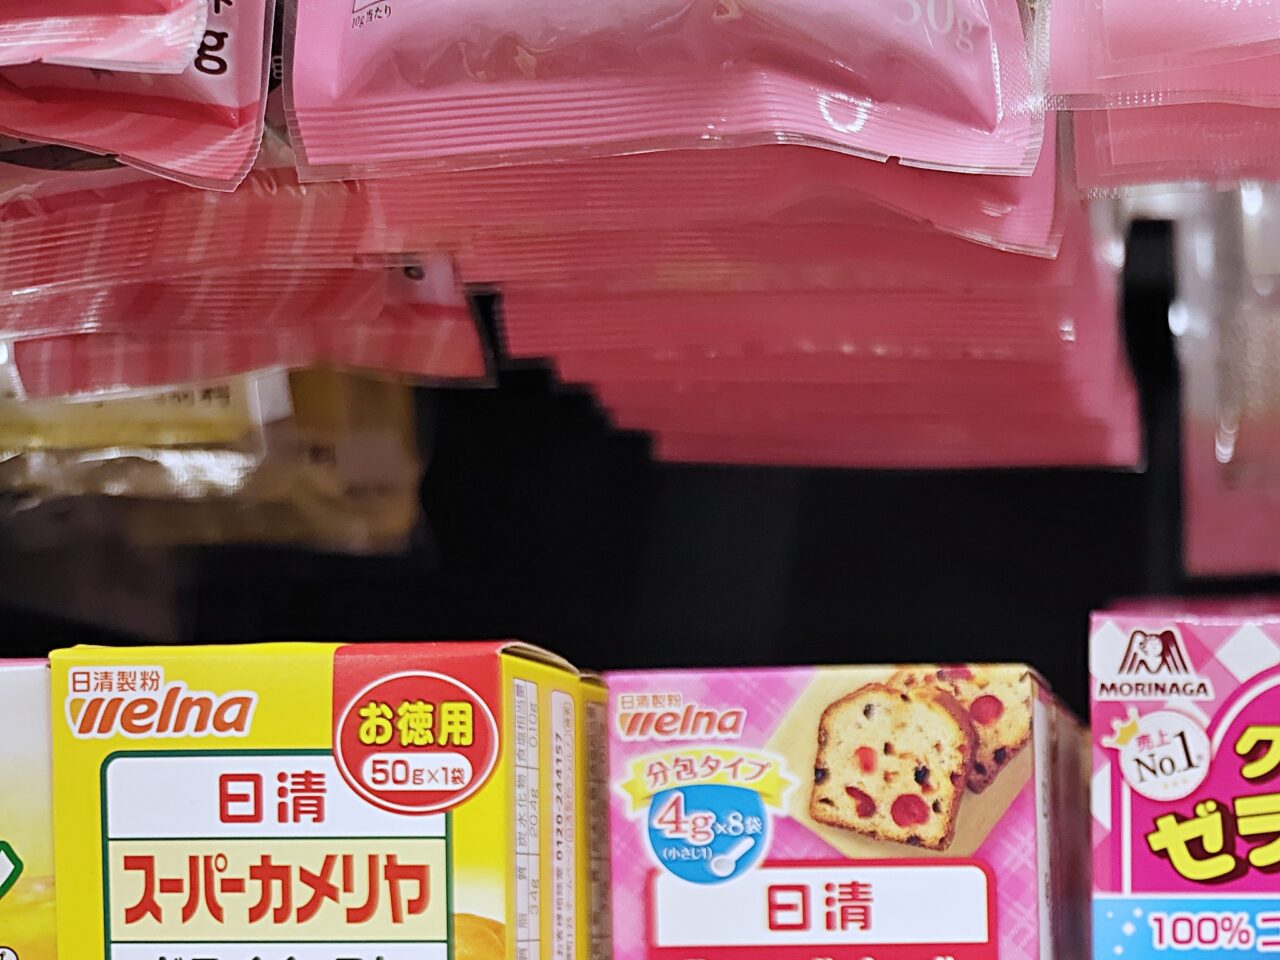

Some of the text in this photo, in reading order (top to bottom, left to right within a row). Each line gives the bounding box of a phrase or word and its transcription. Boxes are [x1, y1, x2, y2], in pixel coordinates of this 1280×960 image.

[71, 671, 161, 693] 日清製粉
[1100, 682, 1209, 697] MORINAGA
[621, 695, 682, 709] 日清製粉
[358, 700, 474, 747] お徳用
[646, 755, 772, 787] 分包タイプ
[218, 770, 328, 825] 日清
[122, 852, 432, 926] スーパーカメリヤ
[767, 881, 874, 932] 日清
